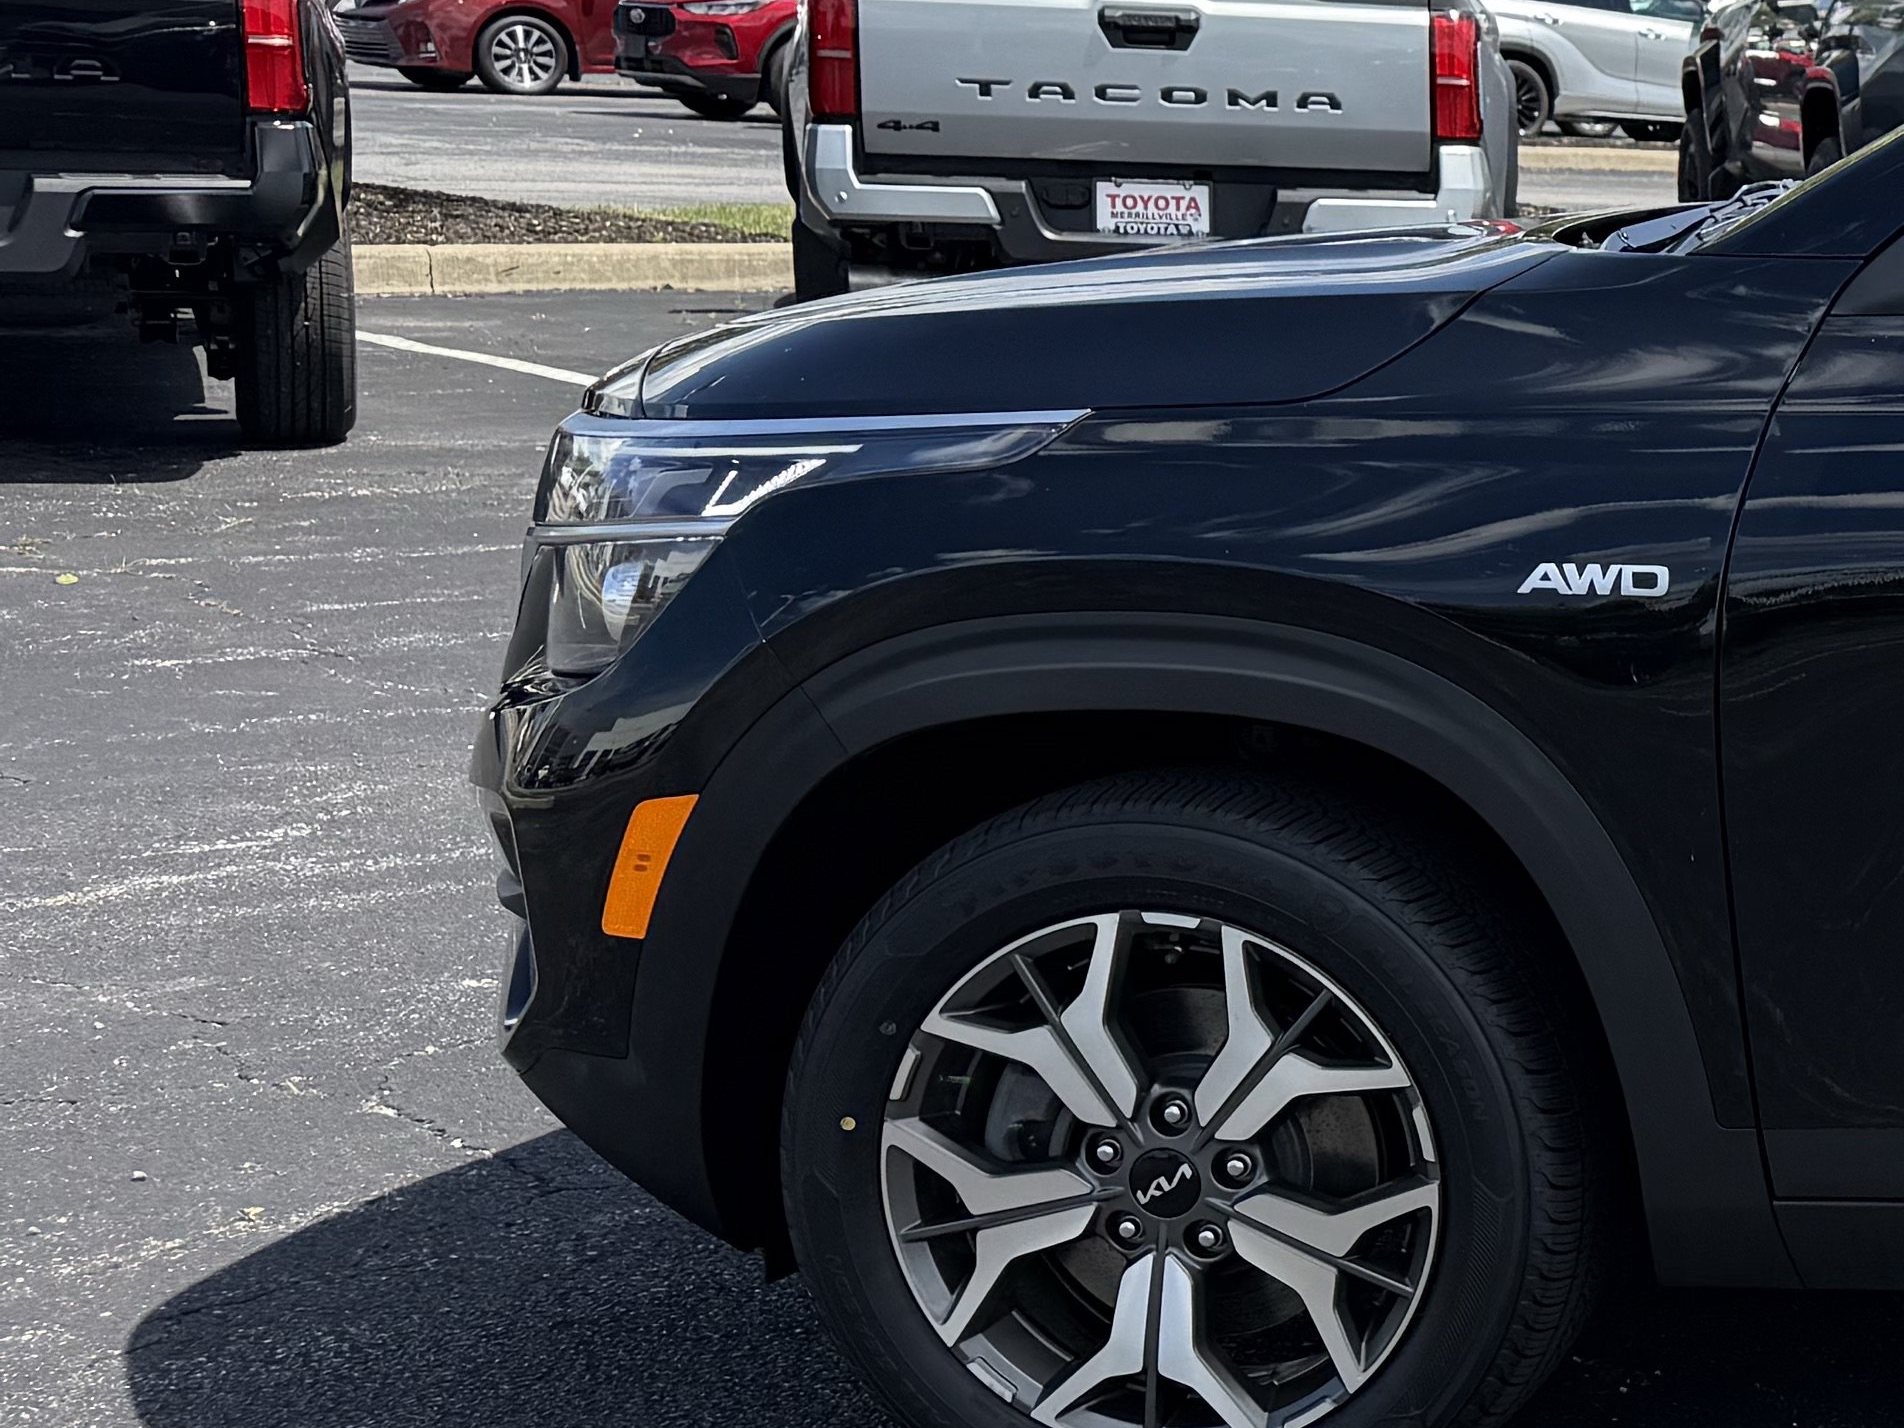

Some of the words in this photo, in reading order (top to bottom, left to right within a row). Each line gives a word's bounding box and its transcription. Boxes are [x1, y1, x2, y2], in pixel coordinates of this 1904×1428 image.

[955, 77, 1343, 114] TACOMA
[1105, 193, 1201, 213] TOYOTA
[1110, 211, 1188, 222] MERRILLVILLE
[1117, 223, 1178, 235] TOYOTA
[1516, 562, 1669, 597] AWD
